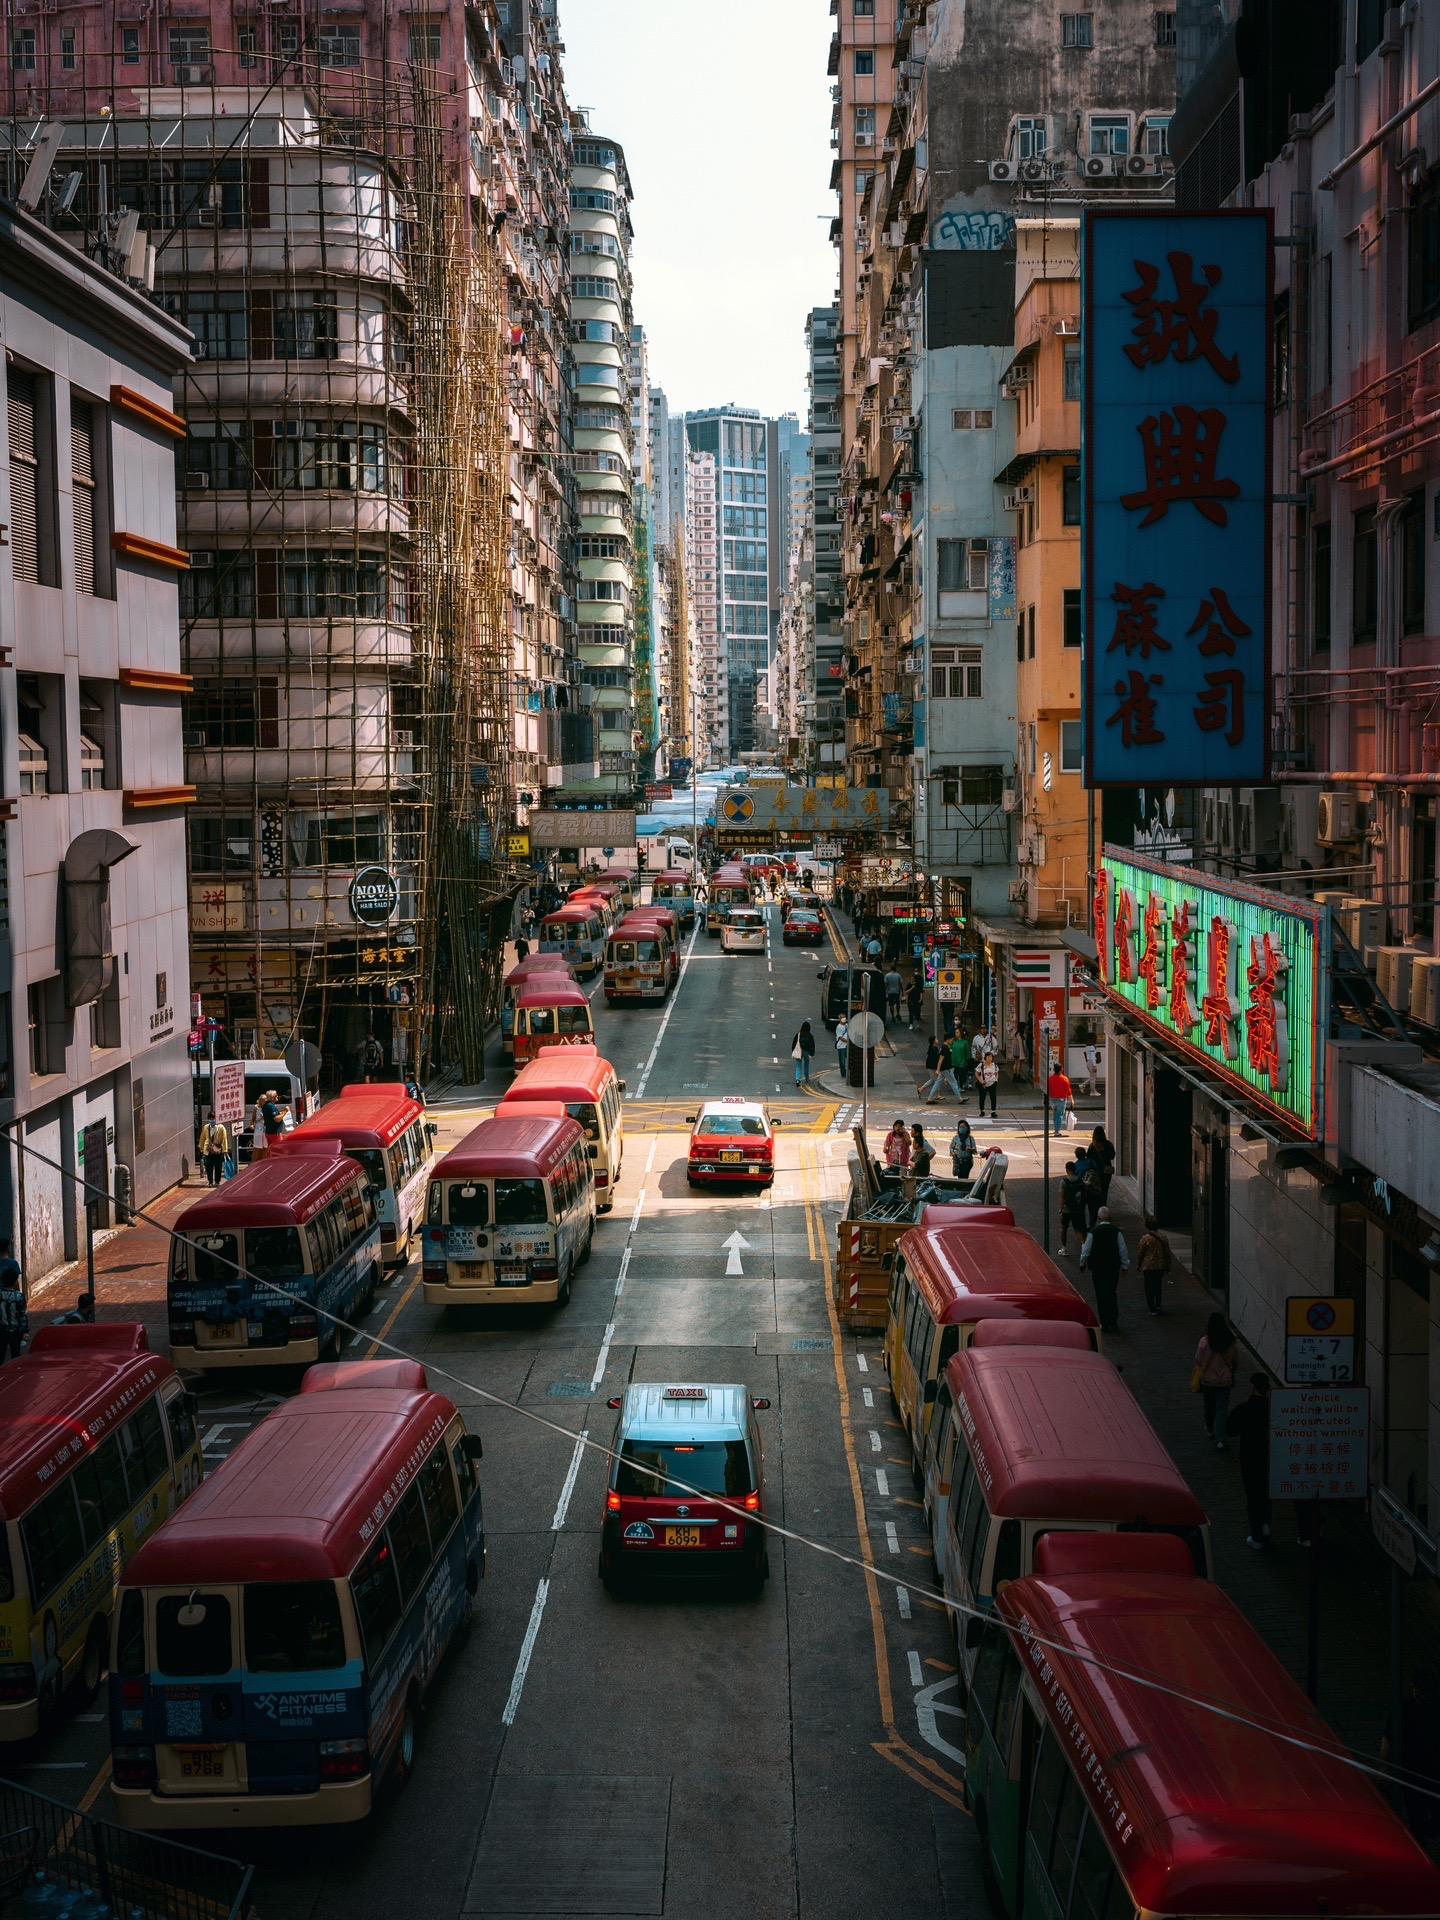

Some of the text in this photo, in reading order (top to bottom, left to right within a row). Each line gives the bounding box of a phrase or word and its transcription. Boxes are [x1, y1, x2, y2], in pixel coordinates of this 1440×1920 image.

[1120, 250, 1241, 527] 誠興
[1186, 588, 1253, 749] 公司
[356, 885, 394, 899] NOVA
[209, 917, 238, 927] SHOP
[1330, 1339, 1340, 1354] 7
[1331, 1365, 1350, 1380] 12
[668, 1388, 703, 1397] TAXI
[1300, 1393, 1341, 1402] Vehicle
[675, 1527, 690, 1537] KH
[668, 1535, 698, 1545] 6099
[279, 1692, 347, 1706] ANYTIME
[1039, 1662, 1054, 1686] BUS
[1055, 1690, 1074, 1726] SEATS
[278, 1703, 347, 1716] FITNESS
